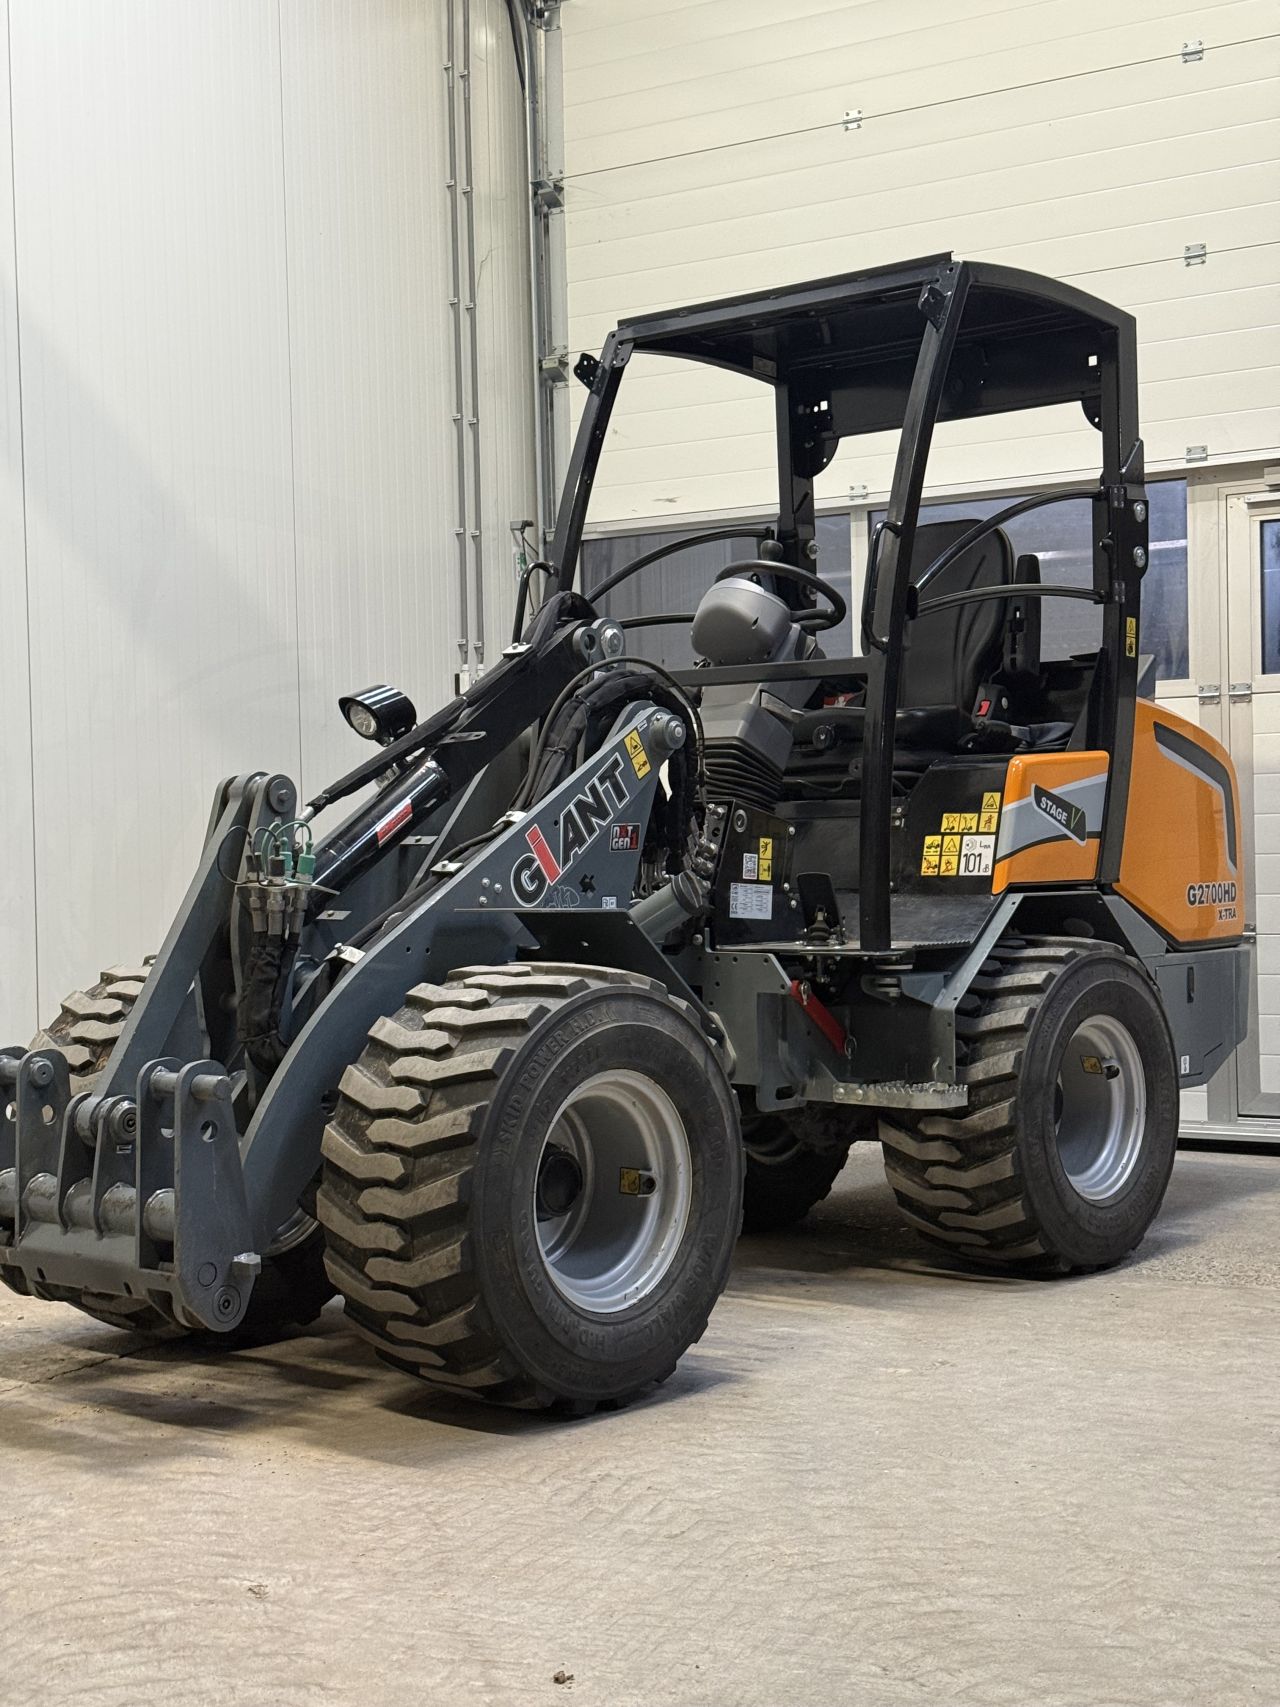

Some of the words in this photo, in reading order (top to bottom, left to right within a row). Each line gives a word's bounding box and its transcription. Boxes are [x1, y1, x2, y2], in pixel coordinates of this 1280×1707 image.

[1040, 796, 1068, 825] STAGE
[1070, 807, 1084, 830] V
[510, 752, 630, 908] GIANT
[962, 852, 983, 874] 101
[1187, 882, 1237, 906] G2700HD
[1217, 907, 1237, 921] X-TRA
[520, 1029, 571, 1093] POWER
